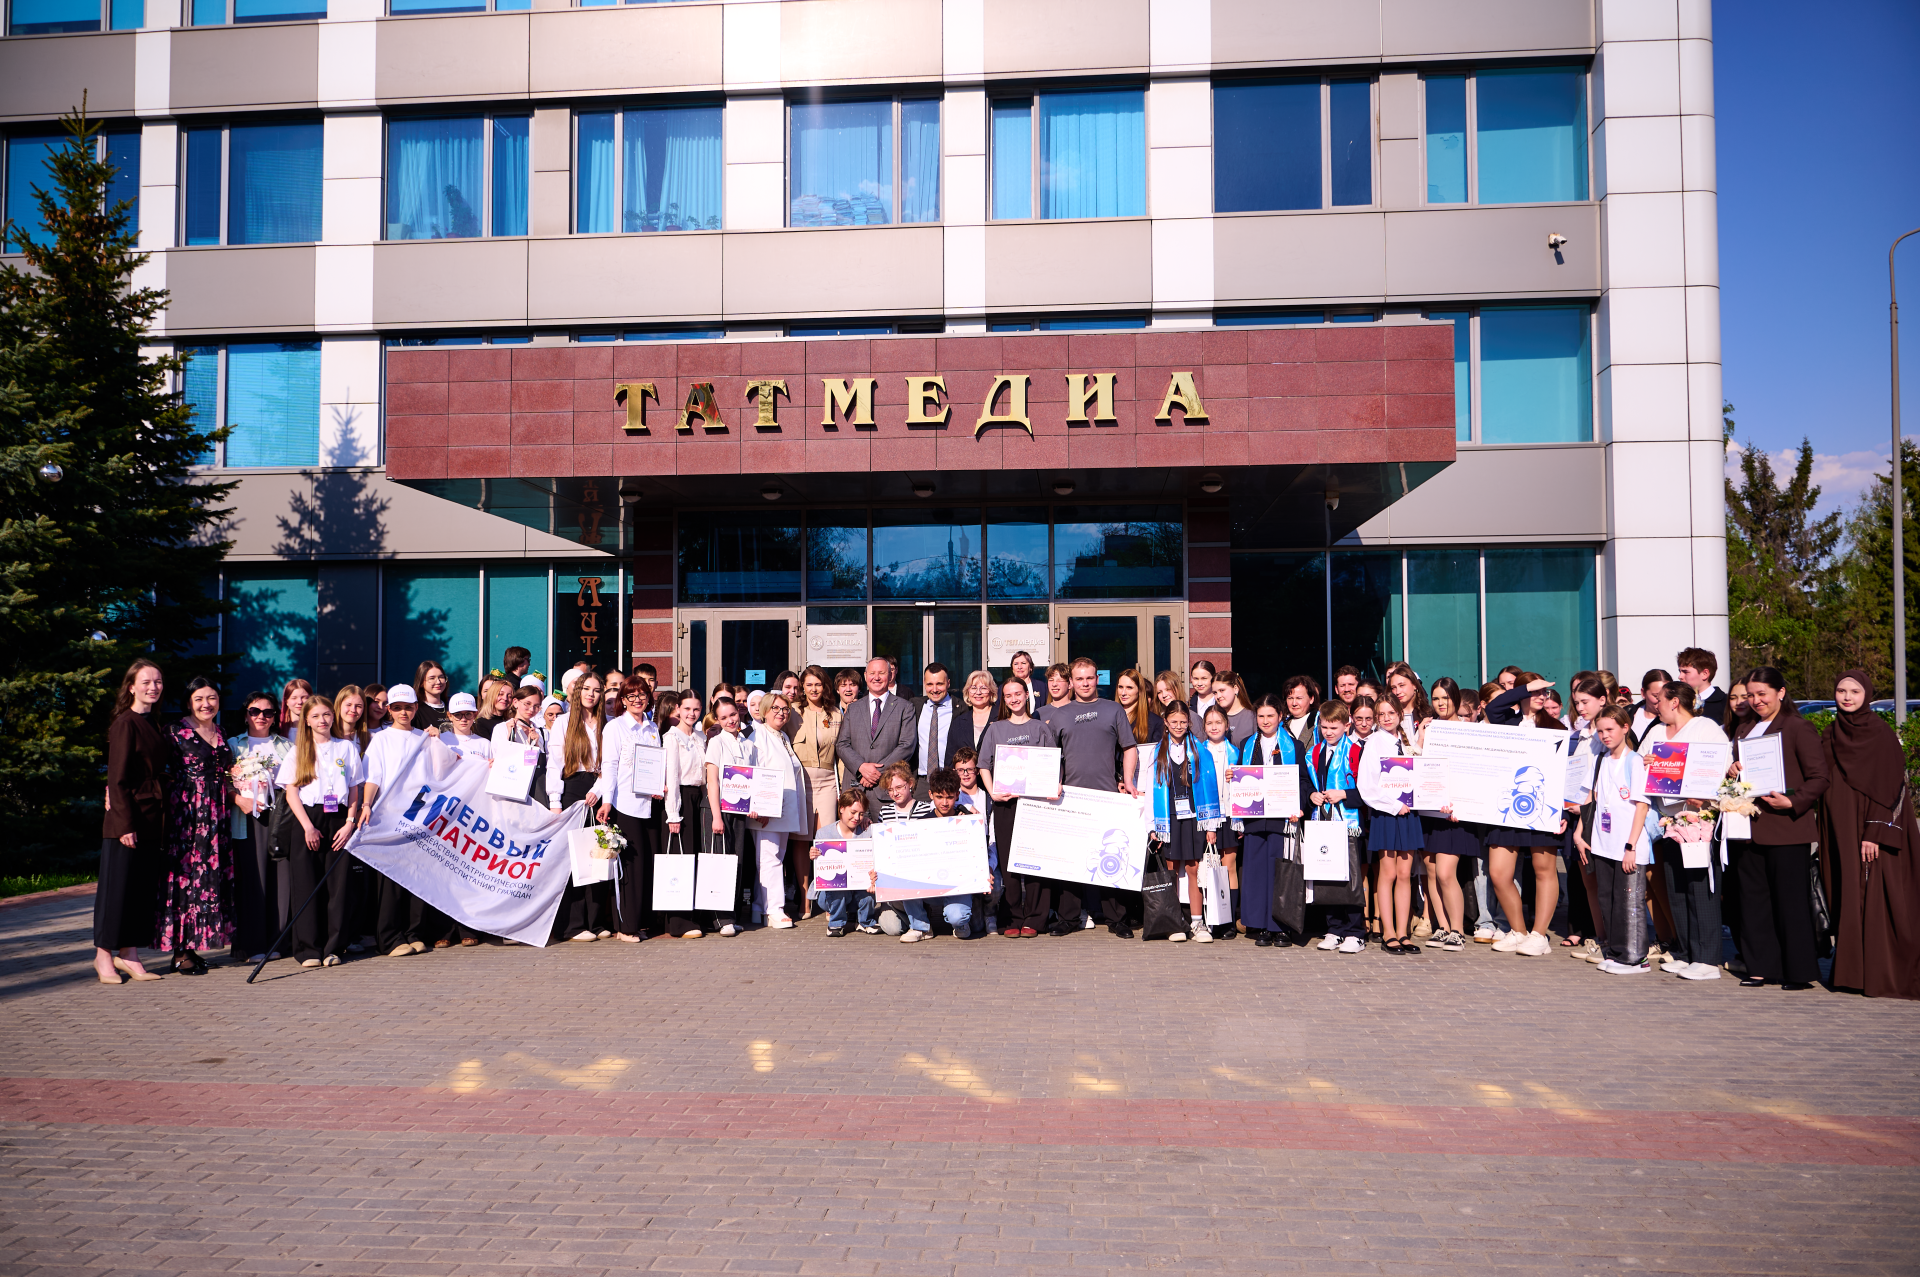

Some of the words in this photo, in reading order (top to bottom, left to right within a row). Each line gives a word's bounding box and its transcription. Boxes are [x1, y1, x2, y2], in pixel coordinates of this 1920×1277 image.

[614, 371, 1209, 436] ТАТМЕДИА
[428, 815, 541, 880] ПАТРИОТ
[445, 796, 551, 860] ПЕРВЫЙ
[444, 859, 496, 892] ВОСПИТАНИЮ
[460, 860, 535, 891] ПАТРИОТИЧЕСКОМУ
